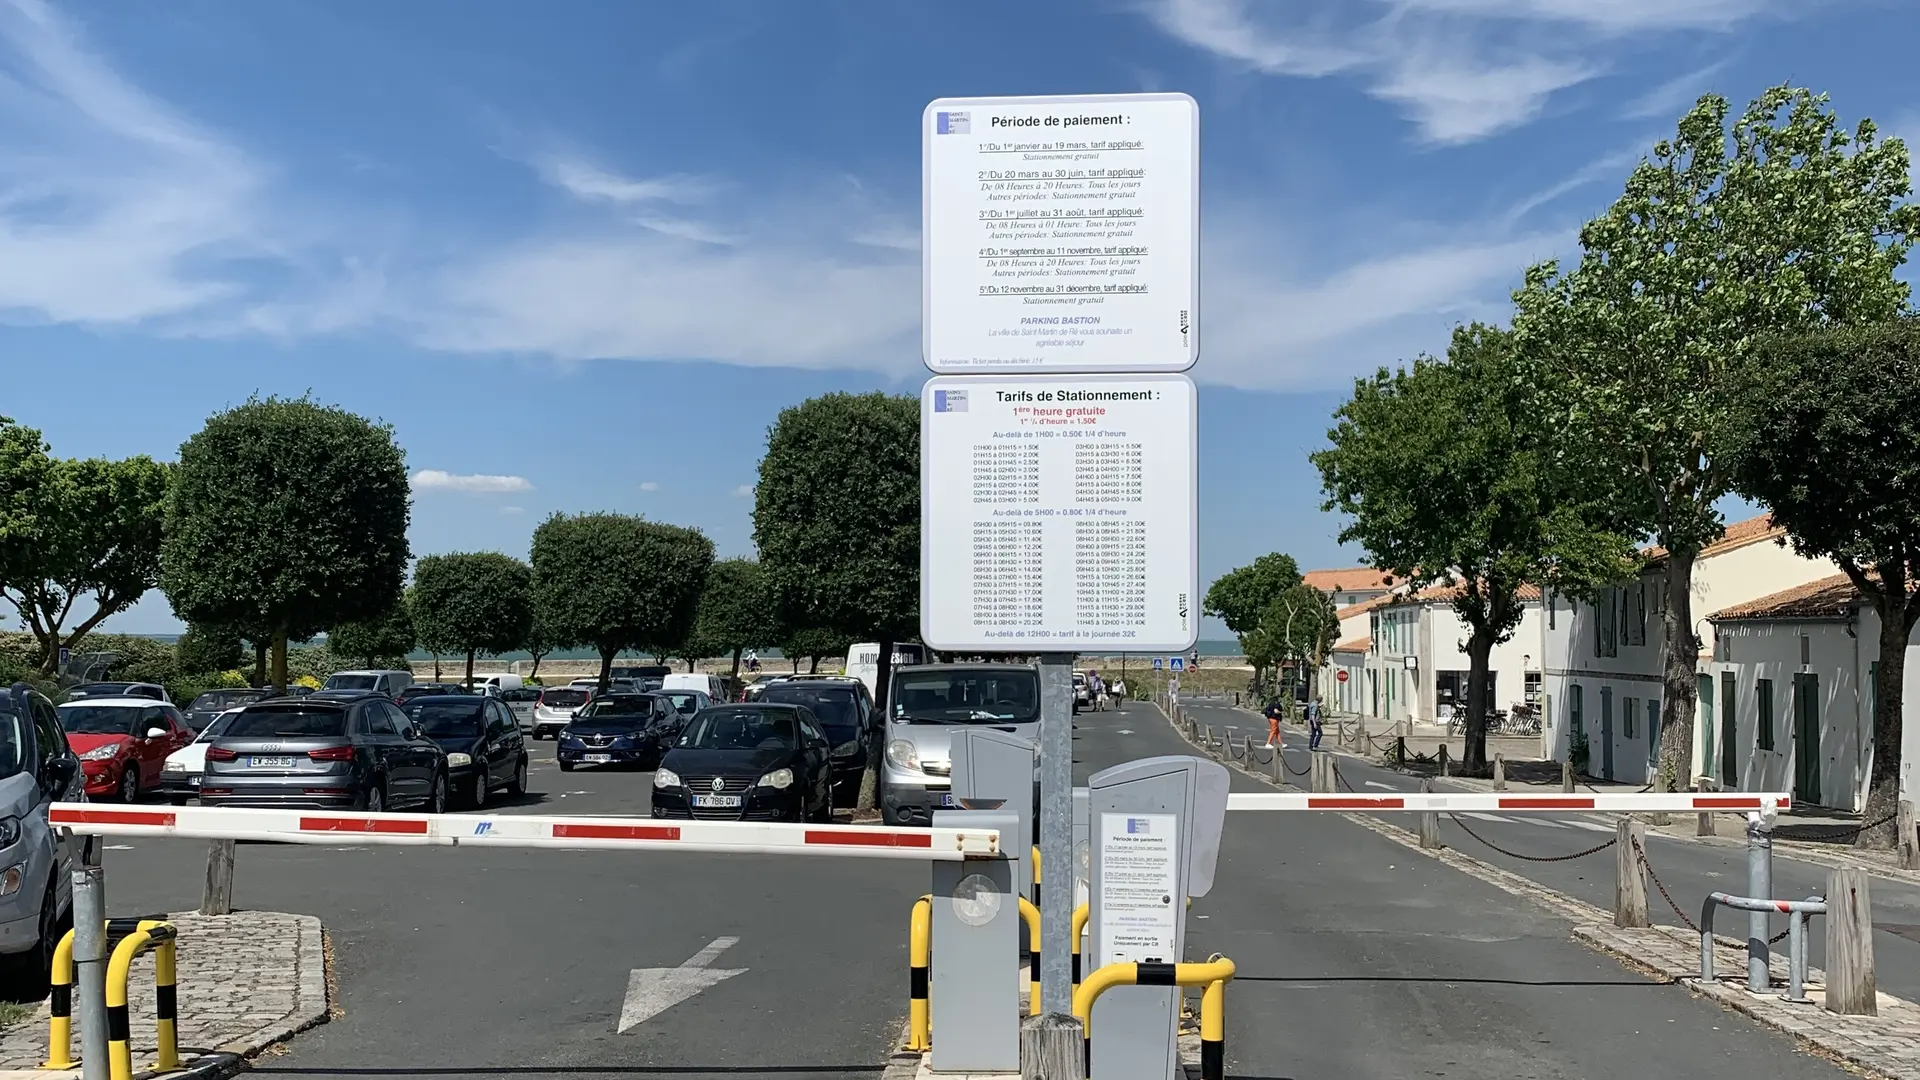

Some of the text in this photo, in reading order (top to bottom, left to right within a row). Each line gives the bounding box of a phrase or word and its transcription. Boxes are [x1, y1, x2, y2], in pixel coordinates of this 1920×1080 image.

[992, 115, 1130, 128] Période de paiement :
[1014, 142, 1040, 152] janvier
[1074, 152, 1099, 161] gratuit
[1121, 181, 1141, 189] jours
[1109, 191, 1136, 200] gratuit
[1016, 210, 1038, 219] juillet
[1116, 220, 1136, 228] jours
[1107, 230, 1133, 239] gratuit
[1009, 247, 1045, 256] septembre
[1110, 268, 1136, 276] gratuit
[1078, 296, 1104, 305] gratuit
[996, 390, 1160, 402] Tarifs de Stationnement :
[1013, 406, 1106, 417] 1ère heure gratuite
[1091, 630, 1120, 638] journée
[891, 653, 914, 664] ESIGN
